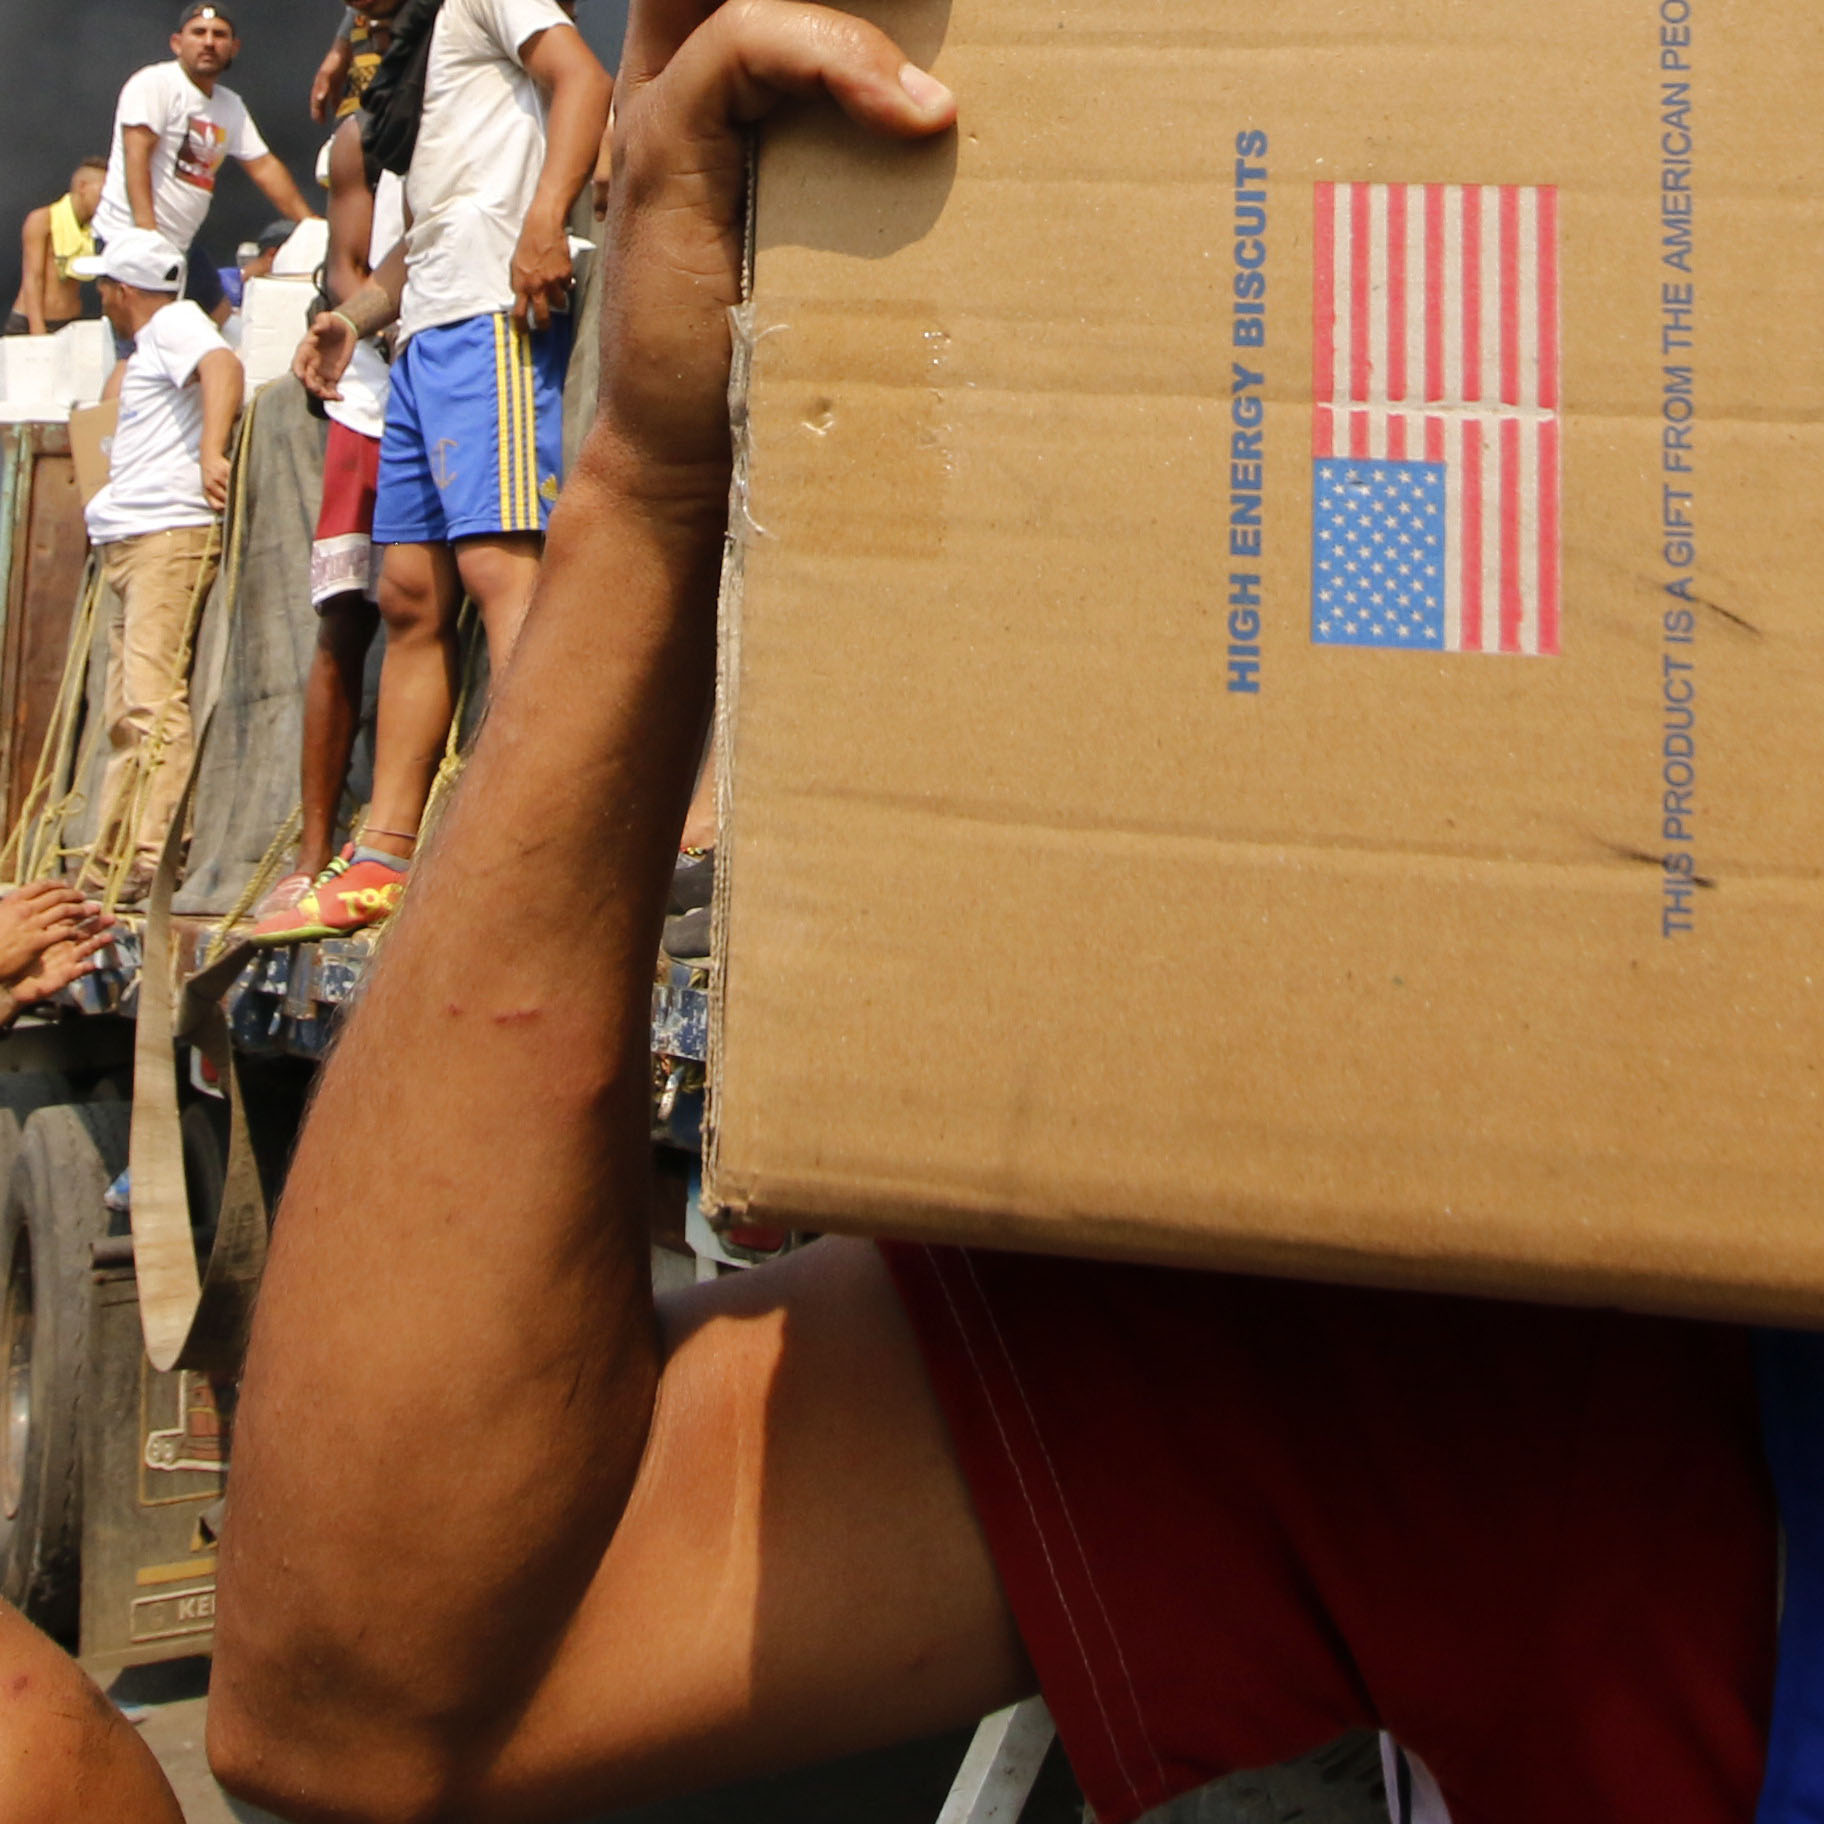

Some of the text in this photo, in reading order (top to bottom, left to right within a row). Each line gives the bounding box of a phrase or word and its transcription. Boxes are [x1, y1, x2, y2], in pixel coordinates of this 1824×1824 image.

[1661, 82, 1692, 272] AMERICAN
[1662, 283, 1693, 355] THE
[1227, 130, 1269, 696] HIGH ENERGY BISCUITS
[1663, 365, 1693, 472] FROM
[1663, 483, 1694, 568] GIFT
[1664, 576, 1694, 603] A
[1664, 609, 1694, 643] IS
[1662, 654, 1694, 842] PRODUCT
[1662, 851, 1693, 938] THIS
